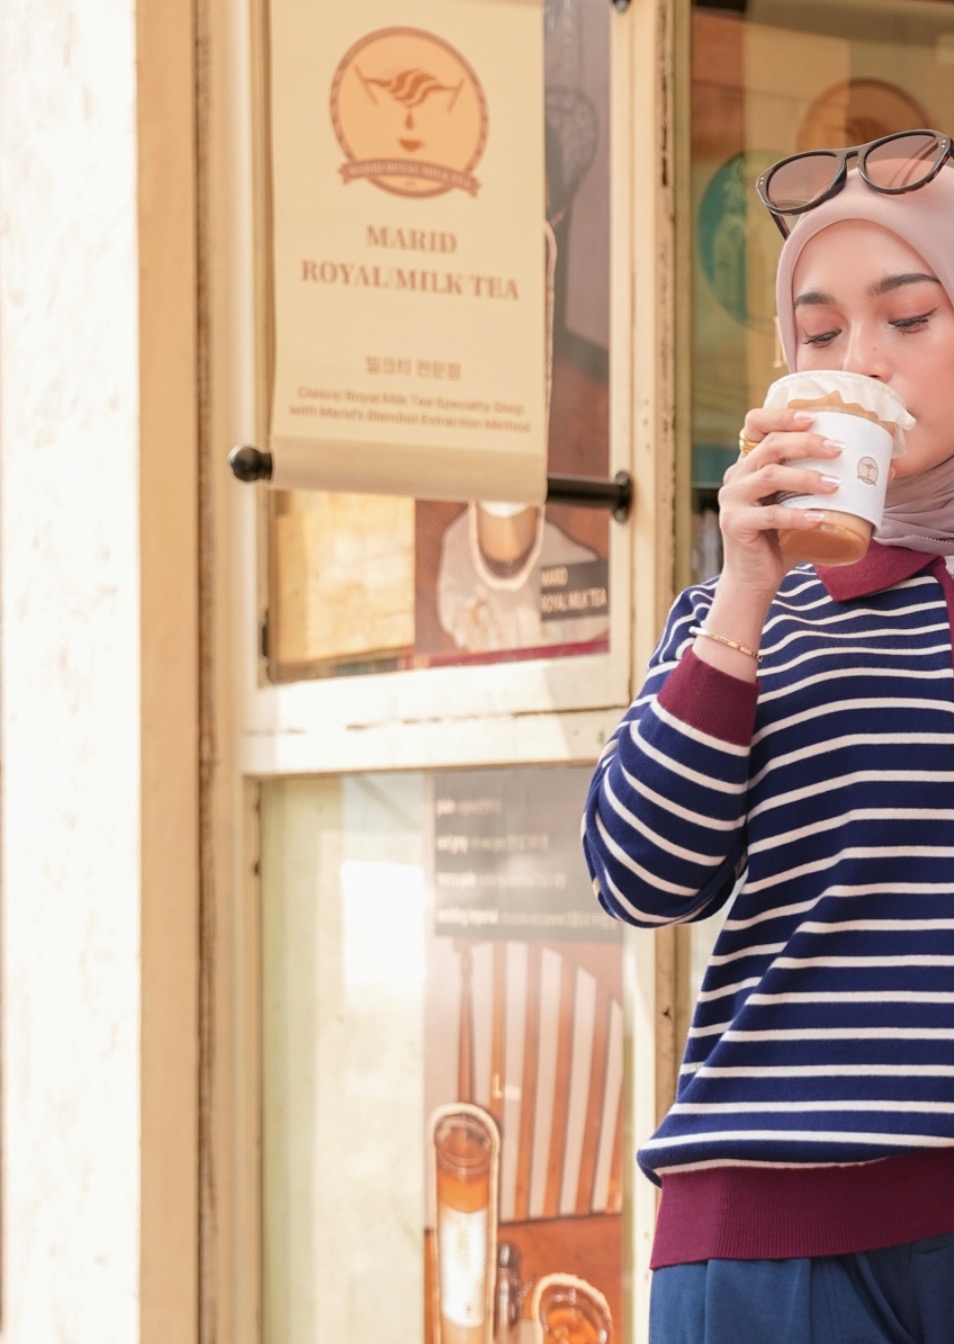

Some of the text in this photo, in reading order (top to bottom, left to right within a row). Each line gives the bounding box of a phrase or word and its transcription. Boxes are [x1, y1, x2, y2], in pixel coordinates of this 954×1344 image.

[366, 224, 458, 254] MARID
[301, 258, 521, 301] ROYAL MILK TEA
